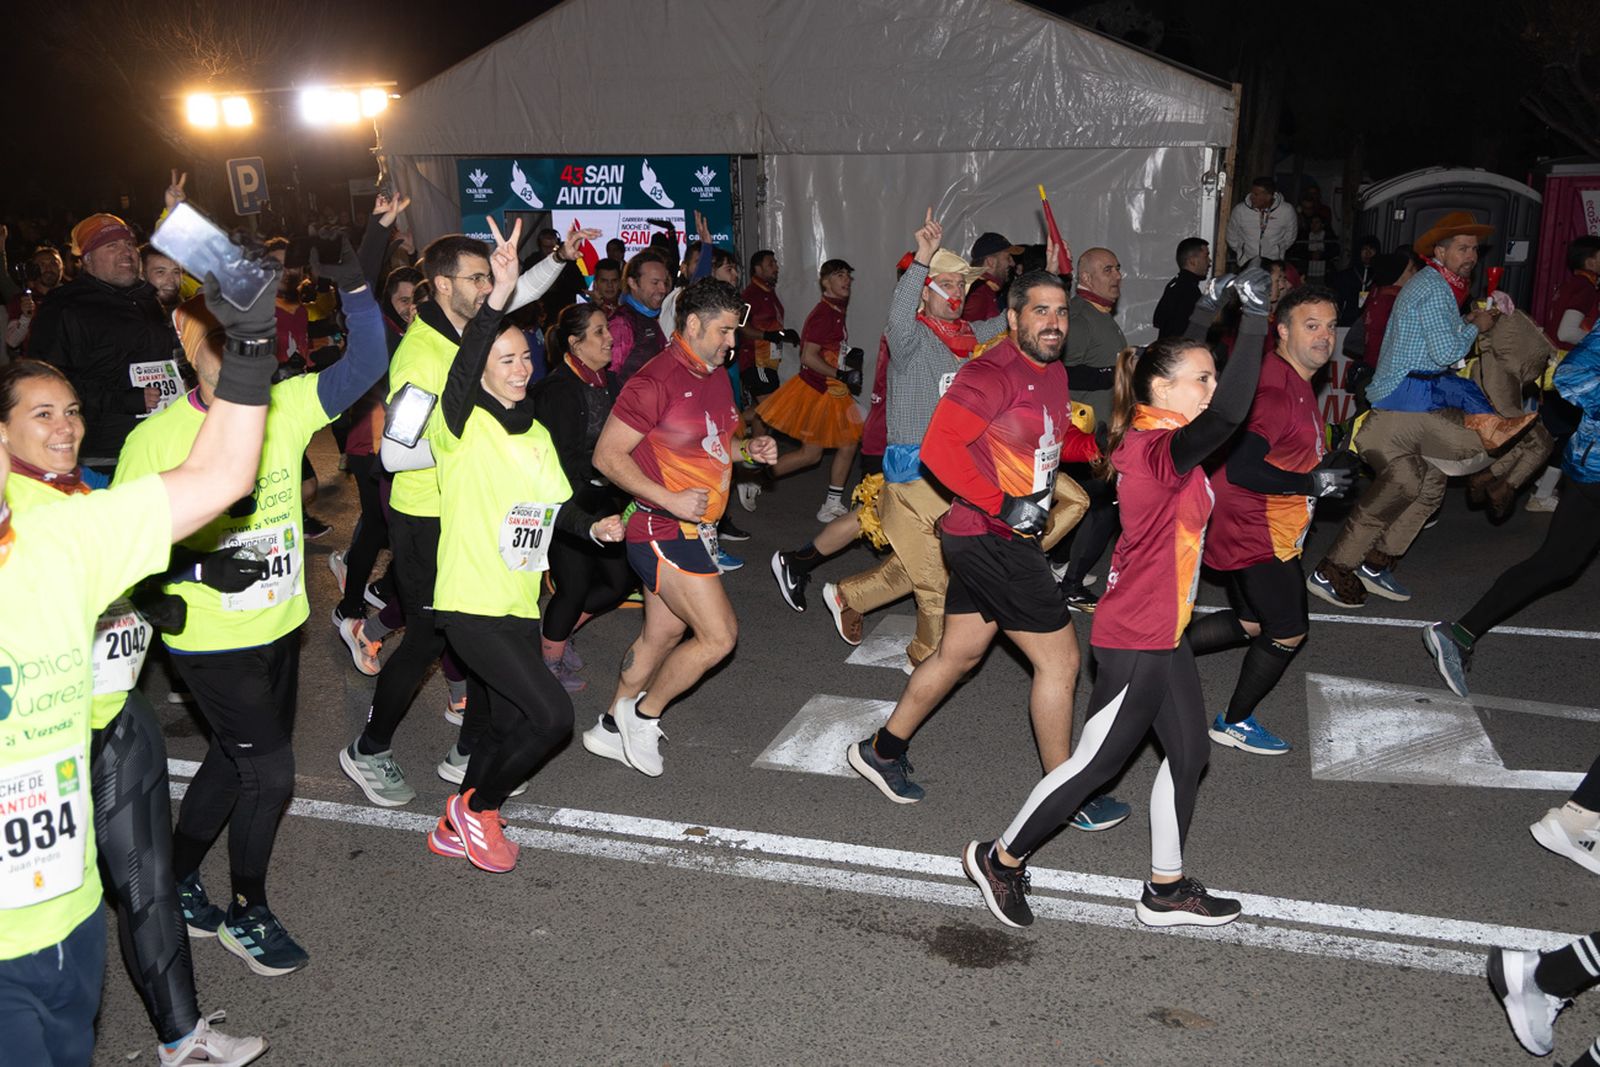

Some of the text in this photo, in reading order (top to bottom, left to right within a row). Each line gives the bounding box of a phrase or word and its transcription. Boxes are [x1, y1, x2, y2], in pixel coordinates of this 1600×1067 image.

[236, 165, 259, 208] P
[520, 187, 533, 201] 43
[556, 182, 623, 205] ANTÓN
[650, 185, 663, 200] 43
[620, 231, 650, 245] SAN
[517, 508, 533, 518] NOCHE
[508, 517, 521, 526] SAN
[269, 535, 278, 545] DE
[512, 527, 543, 549] 3710
[106, 625, 146, 660] 2042
[1225, 727, 1247, 743] HOKA
[28, 774, 44, 790] DE
[0, 800, 77, 862] 934
[8, 850, 61, 874] Juan Pedro
